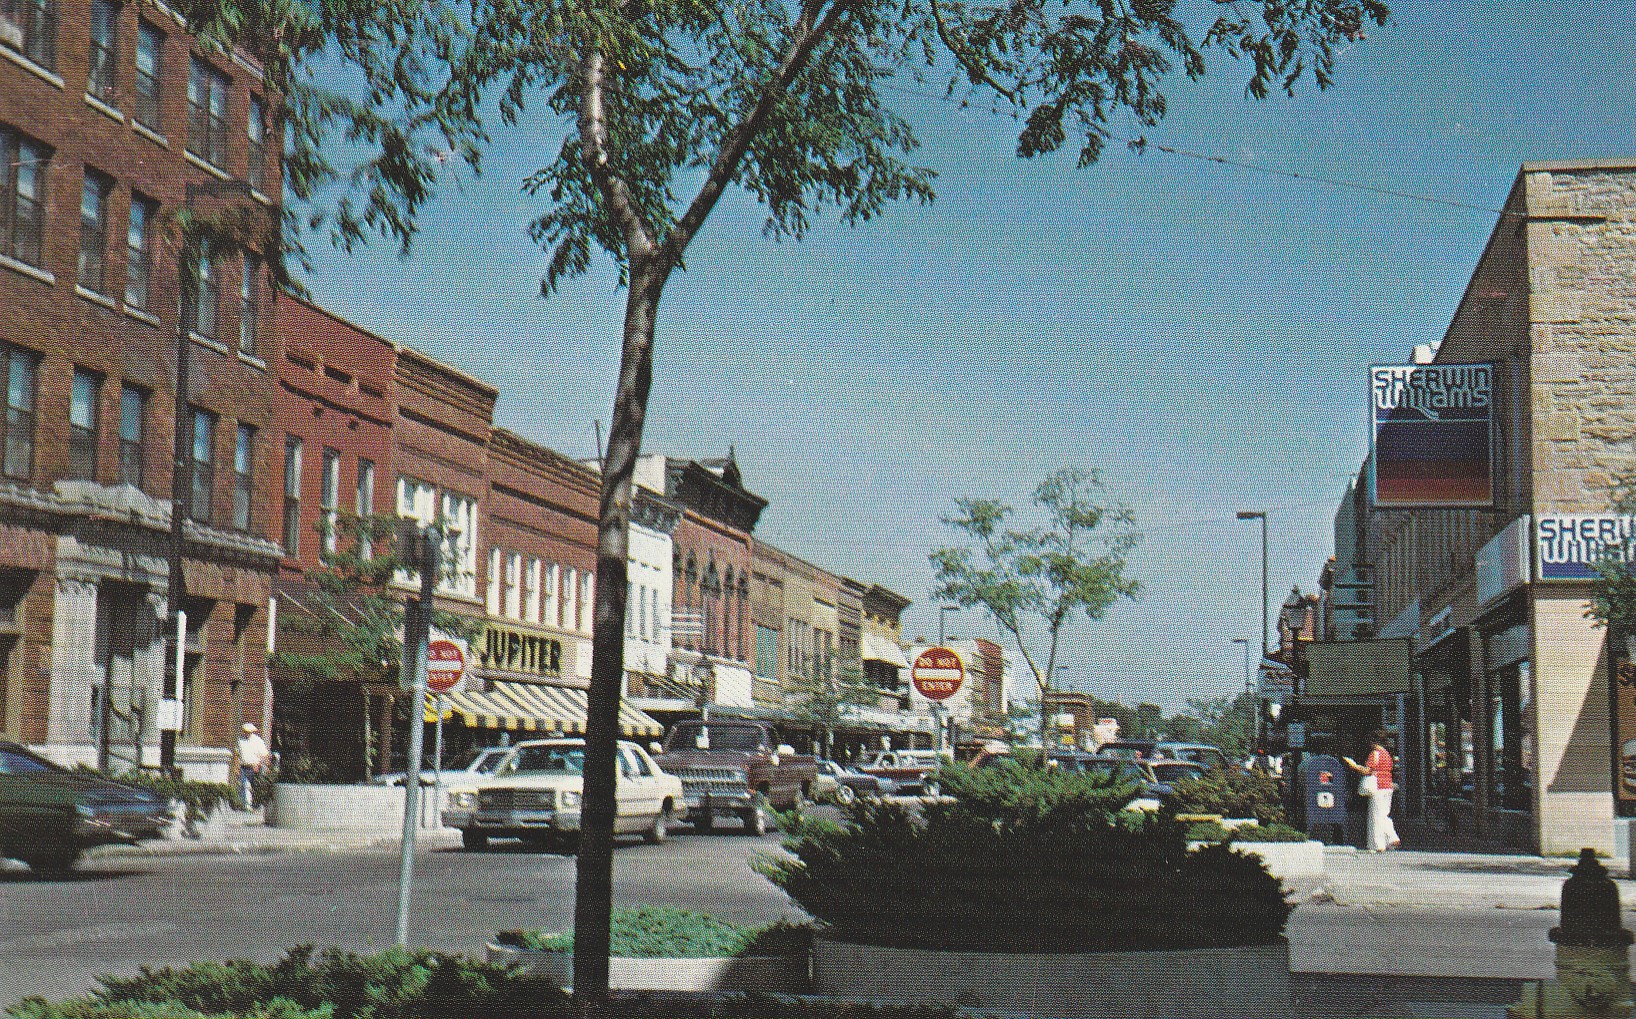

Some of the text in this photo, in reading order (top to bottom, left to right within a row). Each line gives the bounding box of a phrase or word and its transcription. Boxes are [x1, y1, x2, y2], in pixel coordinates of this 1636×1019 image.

[1540, 518, 1636, 541] SHERW
[480, 627, 562, 674] JUPITER
[917, 656, 958, 667] DO NOT
[921, 681, 953, 691] ENTER
